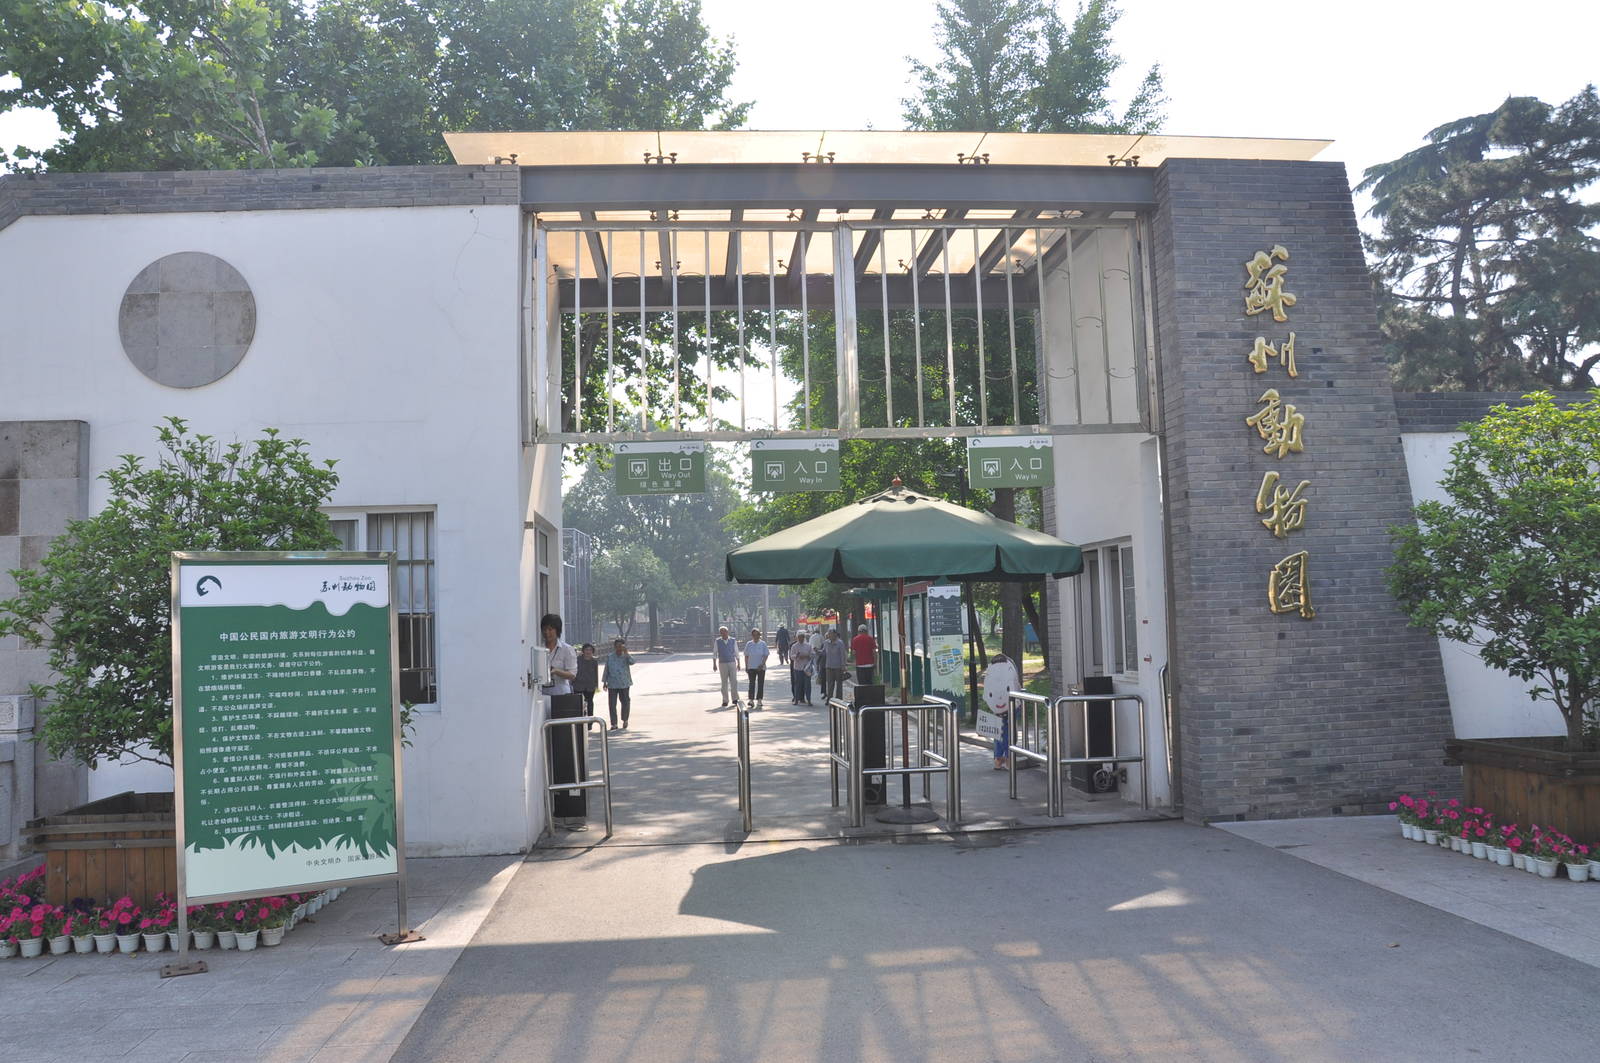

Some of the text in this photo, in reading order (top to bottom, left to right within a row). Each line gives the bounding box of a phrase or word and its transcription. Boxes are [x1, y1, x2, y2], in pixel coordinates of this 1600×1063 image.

[659, 457, 692, 472] 出口
[793, 461, 827, 474] 入口
[1010, 457, 1042, 471] 入口
[661, 471, 691, 480] Way Out
[219, 628, 356, 641] 中国公民国内旅游文明行为公约
